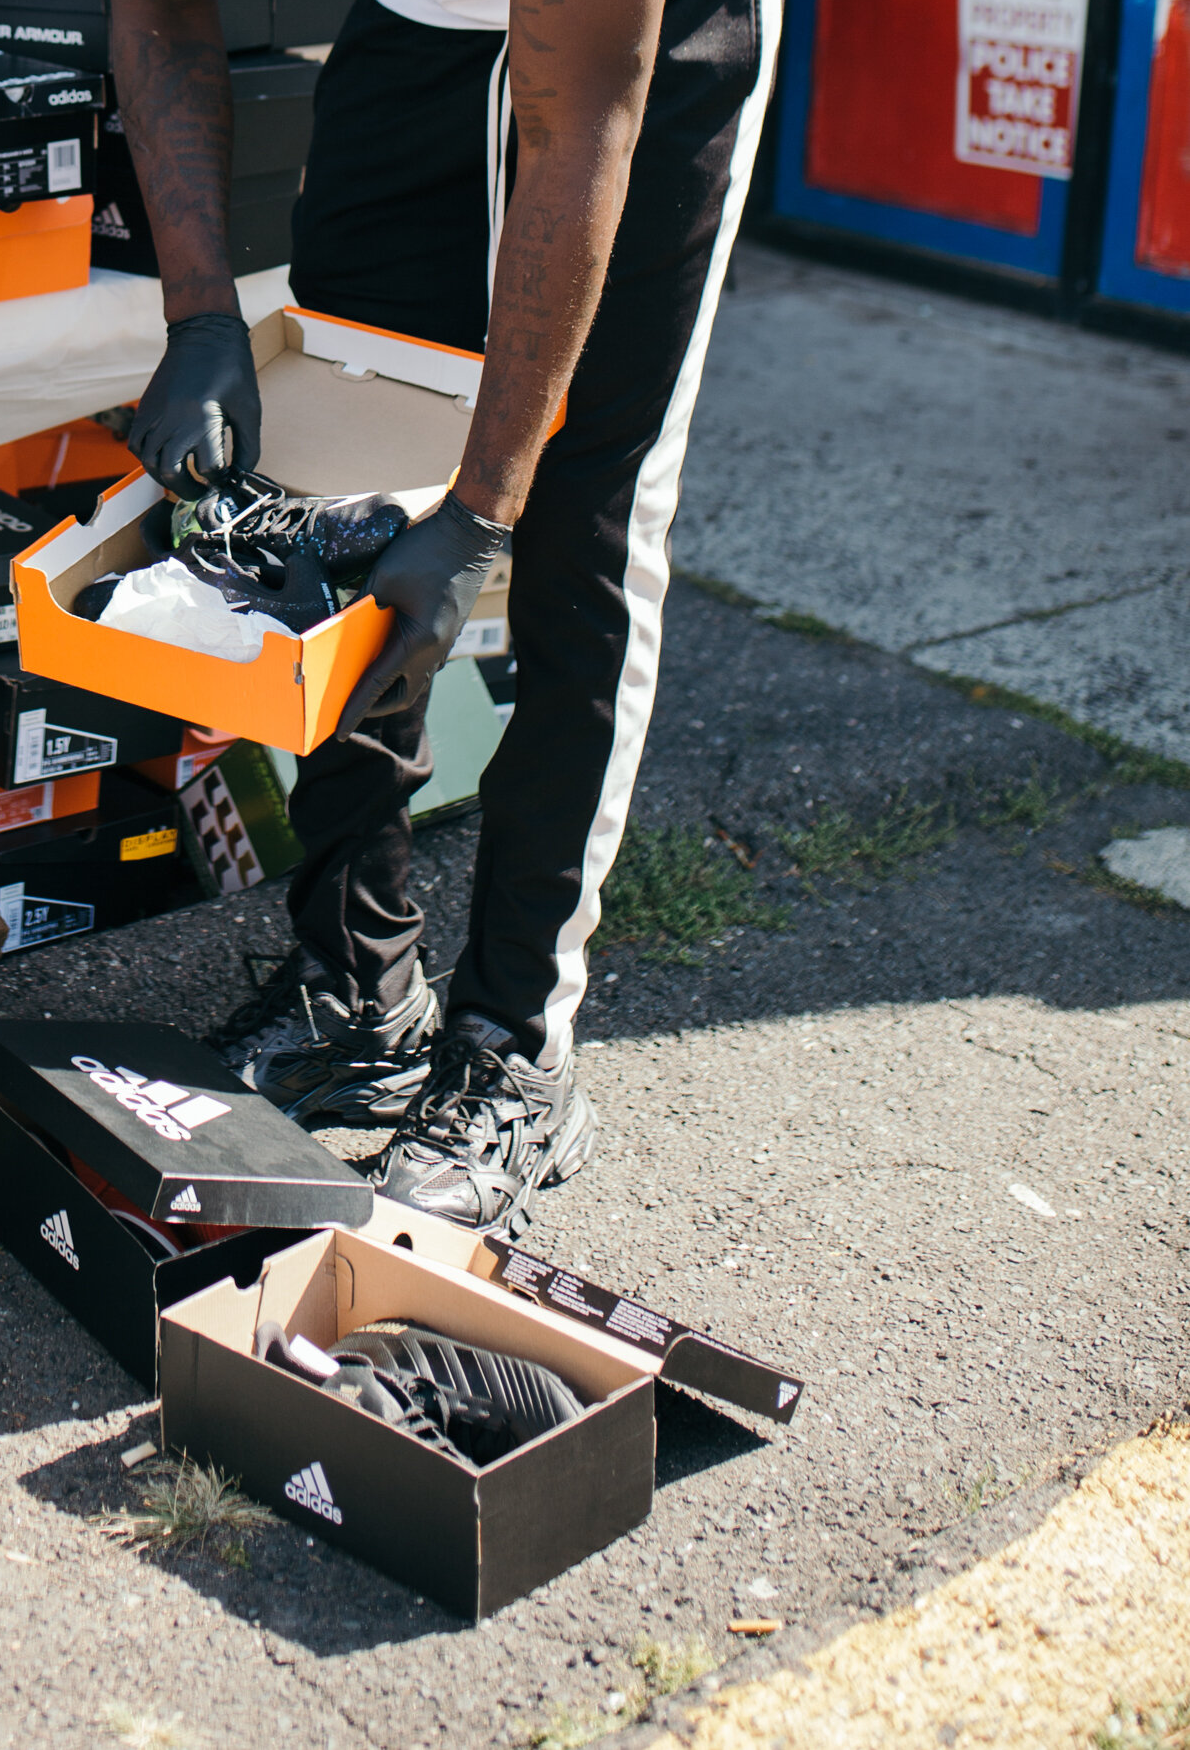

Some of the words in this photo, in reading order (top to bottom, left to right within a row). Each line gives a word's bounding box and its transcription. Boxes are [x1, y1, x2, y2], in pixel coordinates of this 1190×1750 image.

[14, 26, 82, 46] ARMOUR
[972, 43, 1070, 88] POLICE
[48, 88, 93, 107] adidas
[986, 77, 1056, 123] TAKE
[969, 114, 1070, 164] NOTICE
[46, 736, 71, 756] 1.5Y
[24, 906, 50, 926] 2.5Y
[70, 1055, 192, 1141] adidas
[170, 1199, 201, 1212] adidas
[40, 1223, 80, 1271] adidas
[285, 1480, 343, 1525] adidas
